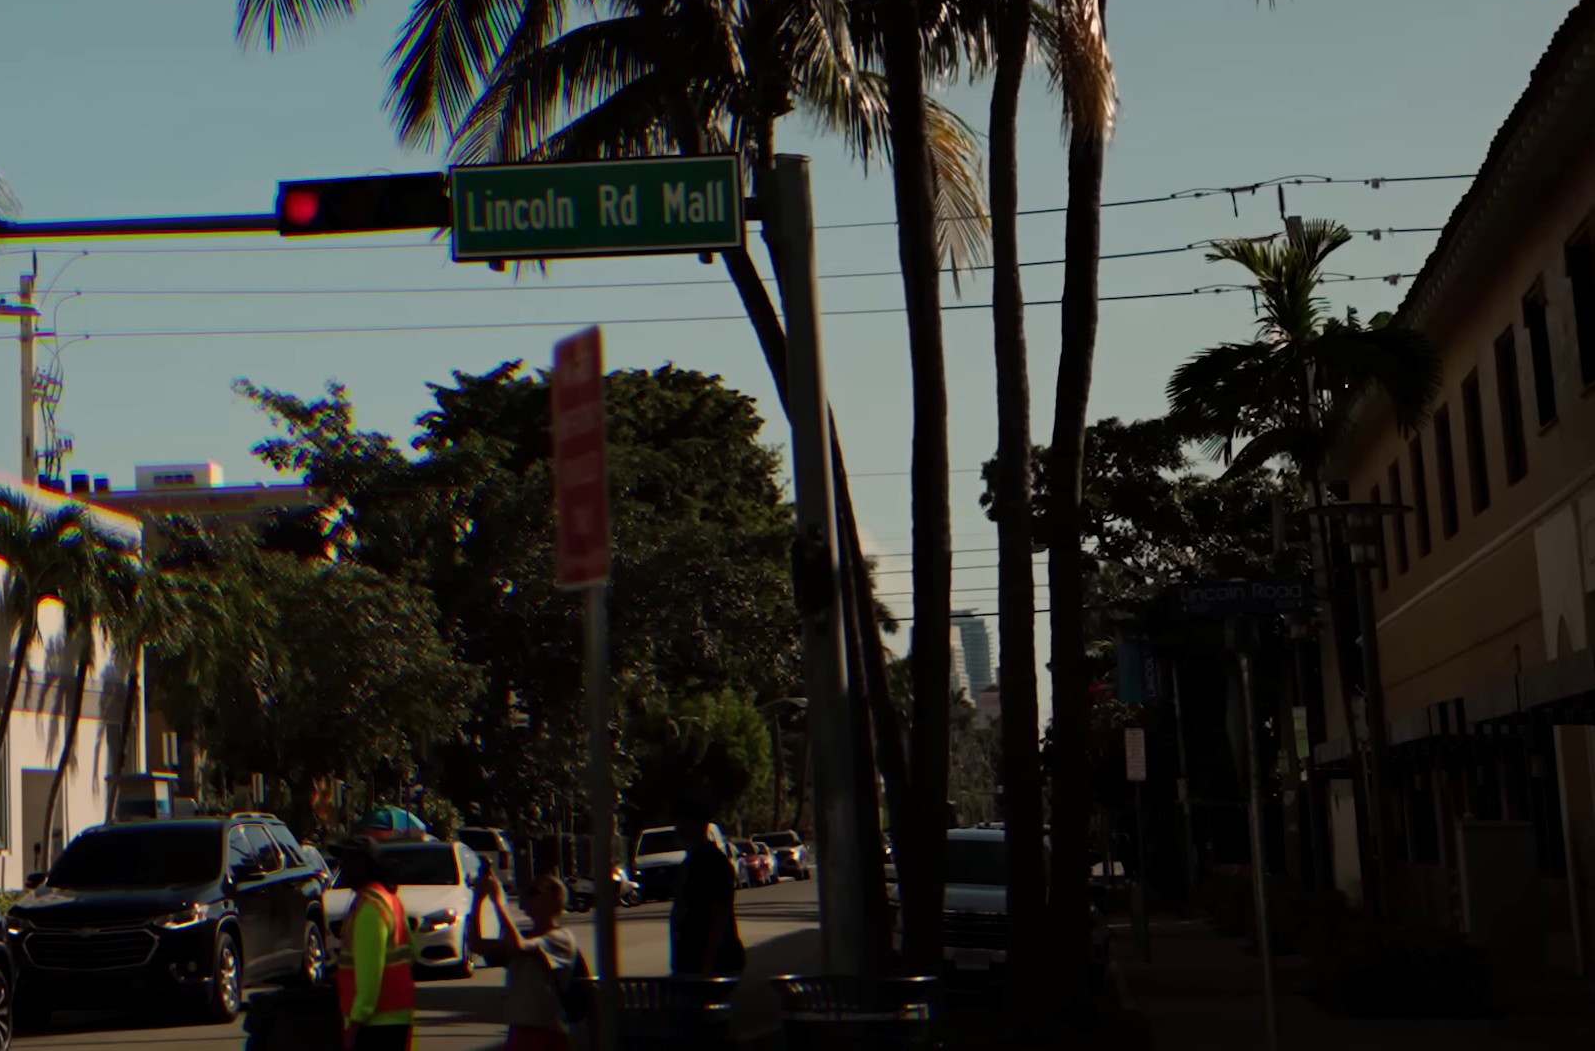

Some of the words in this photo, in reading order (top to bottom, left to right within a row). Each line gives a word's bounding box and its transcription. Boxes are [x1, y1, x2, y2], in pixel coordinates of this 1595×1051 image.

[466, 188, 574, 232] Lincoln
[598, 184, 637, 226] Rd
[662, 180, 725, 224] Mall
[1252, 582, 1302, 599] Road
